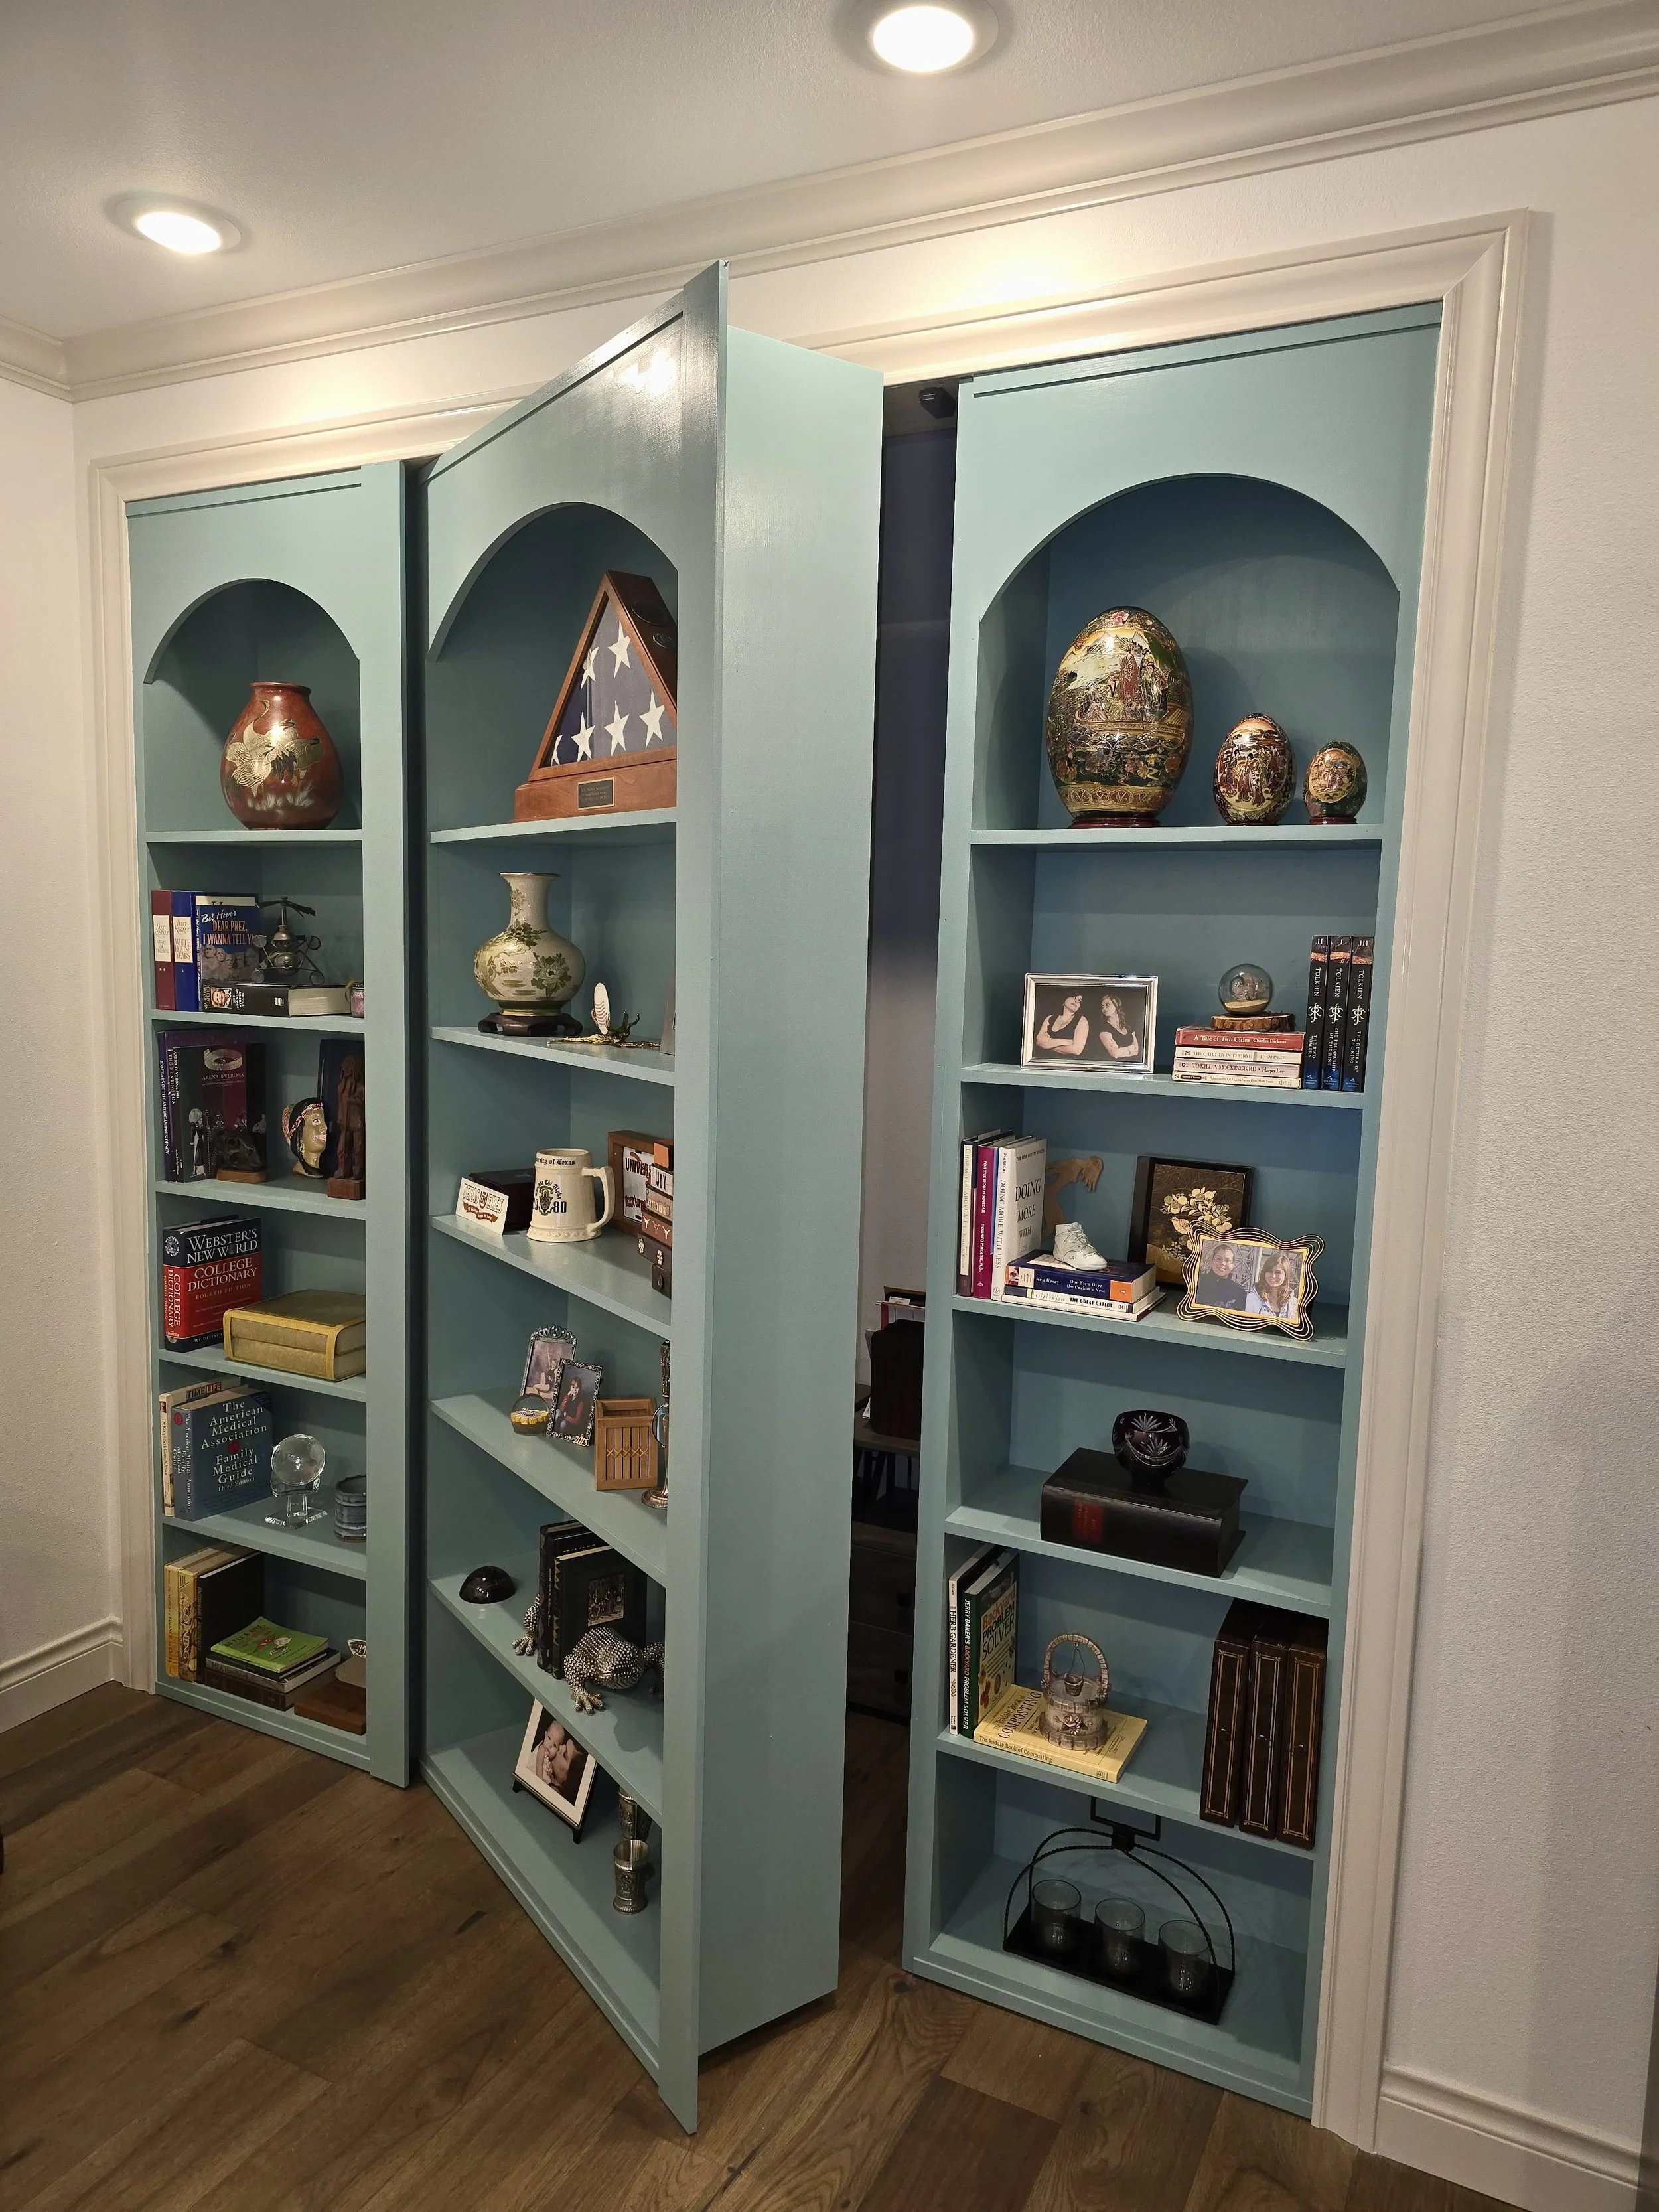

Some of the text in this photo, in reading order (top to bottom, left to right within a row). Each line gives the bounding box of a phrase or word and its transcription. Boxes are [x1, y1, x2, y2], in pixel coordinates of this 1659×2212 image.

[201, 909, 237, 923] Bob Hope's
[212, 920, 248, 932] DEAR PREZ,
[202, 934, 247, 945] I WANNA TELL
[656, 1171, 666, 1190] JOY
[1015, 1178, 1041, 1202] DOING
[463, 1183, 504, 1213] TEXAS EXES
[553, 1201, 567, 1213] 80
[1017, 1204, 1036, 1223] MORE
[186, 1228, 257, 1252] WEBSTER'S
[1019, 1226, 1031, 1239] WITH
[186, 1248, 216, 1264] NEW
[217, 1240, 258, 1257] WORLD
[194, 1257, 252, 1280] COLLEGE
[187, 1267, 257, 1291] DICTIONARY
[196, 1283, 251, 1300] FOURTH EDITION
[186, 1382, 221, 1399] TIME LIFE
[210, 1407, 263, 1426] American
[222, 1402, 245, 1412] The
[212, 1416, 257, 1436] Medical
[200, 1425, 267, 1449] Association
[212, 1455, 257, 1477] Medical
[216, 1448, 253, 1465] Family
[218, 1468, 253, 1484] Guide
[218, 1477, 255, 1491] Third Edition
[182, 1593, 190, 1659] ACCOUNTING
[983, 1600, 1015, 1643] PROBLEM
[982, 1613, 1014, 1661] SOLVER
[997, 1692, 1042, 1739] COMPOSTING
[989, 1738, 1005, 1747] Rodale
[1005, 1743, 1017, 1751] Book
[1023, 1749, 1052, 1763] Composting
